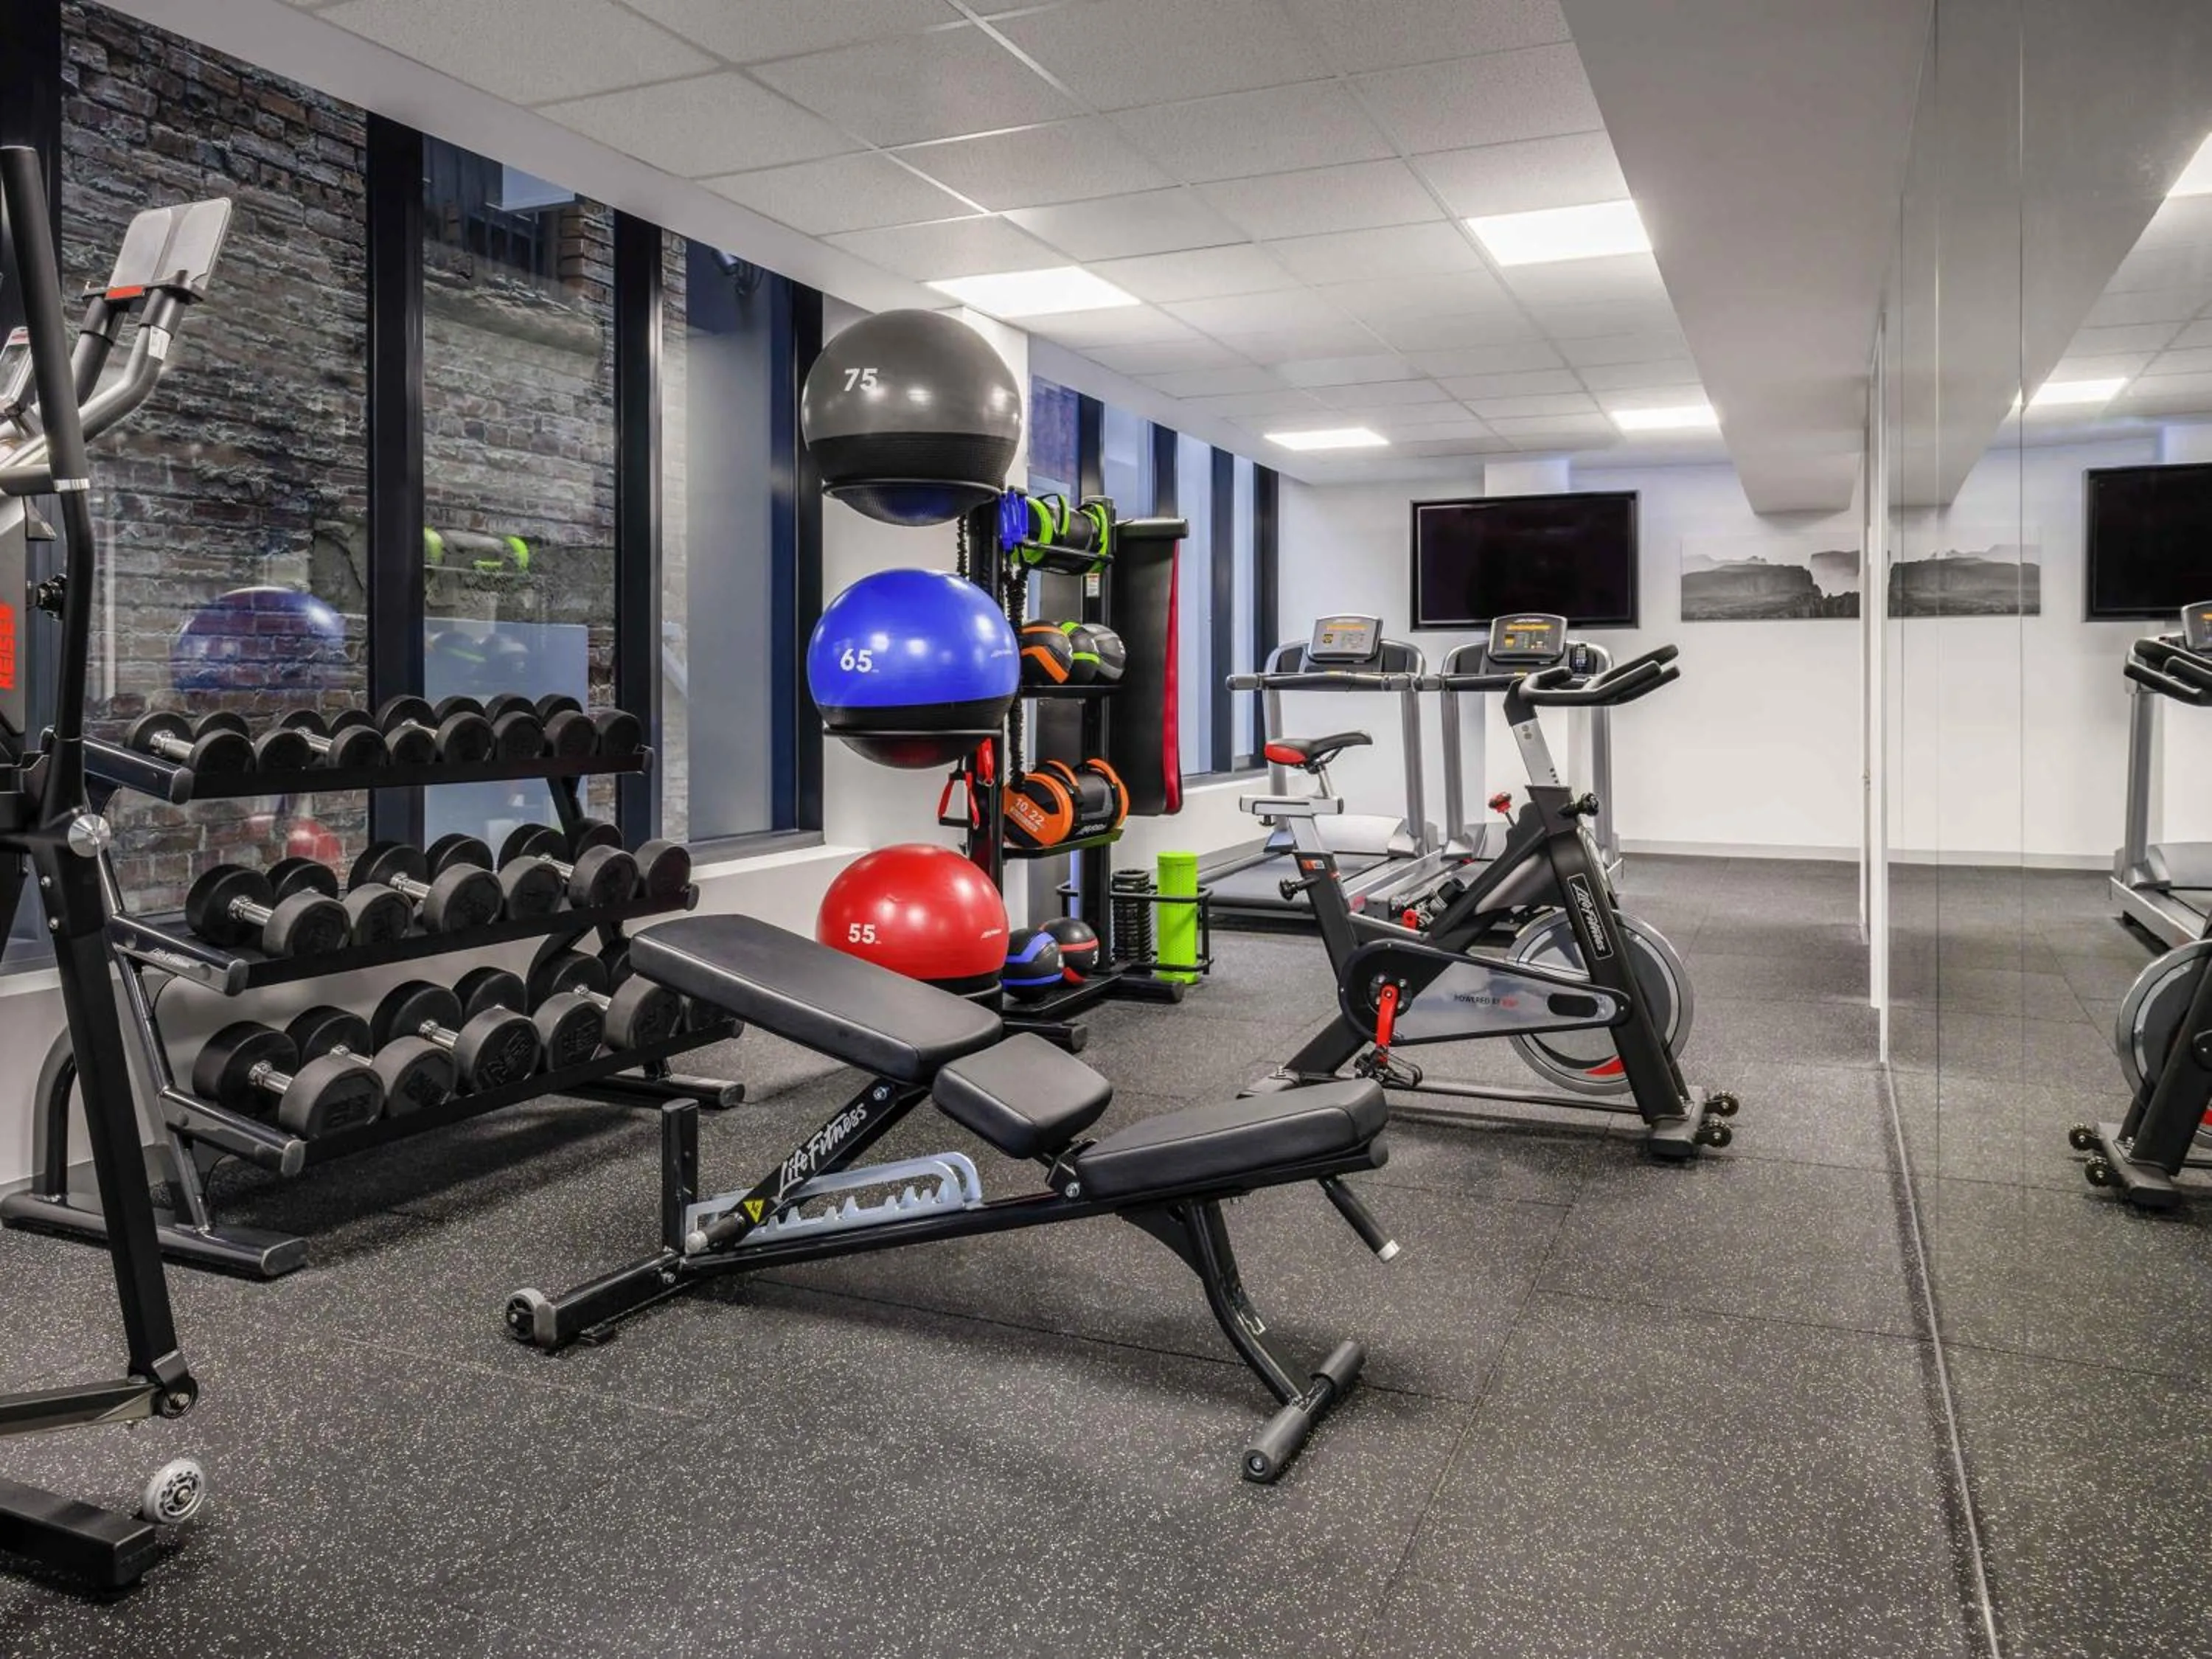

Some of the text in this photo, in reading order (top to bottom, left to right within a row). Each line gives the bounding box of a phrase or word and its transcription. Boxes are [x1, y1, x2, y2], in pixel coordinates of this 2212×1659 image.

[844, 368, 878, 392] 75
[840, 648, 873, 672] 65
[847, 922, 876, 945] 55
